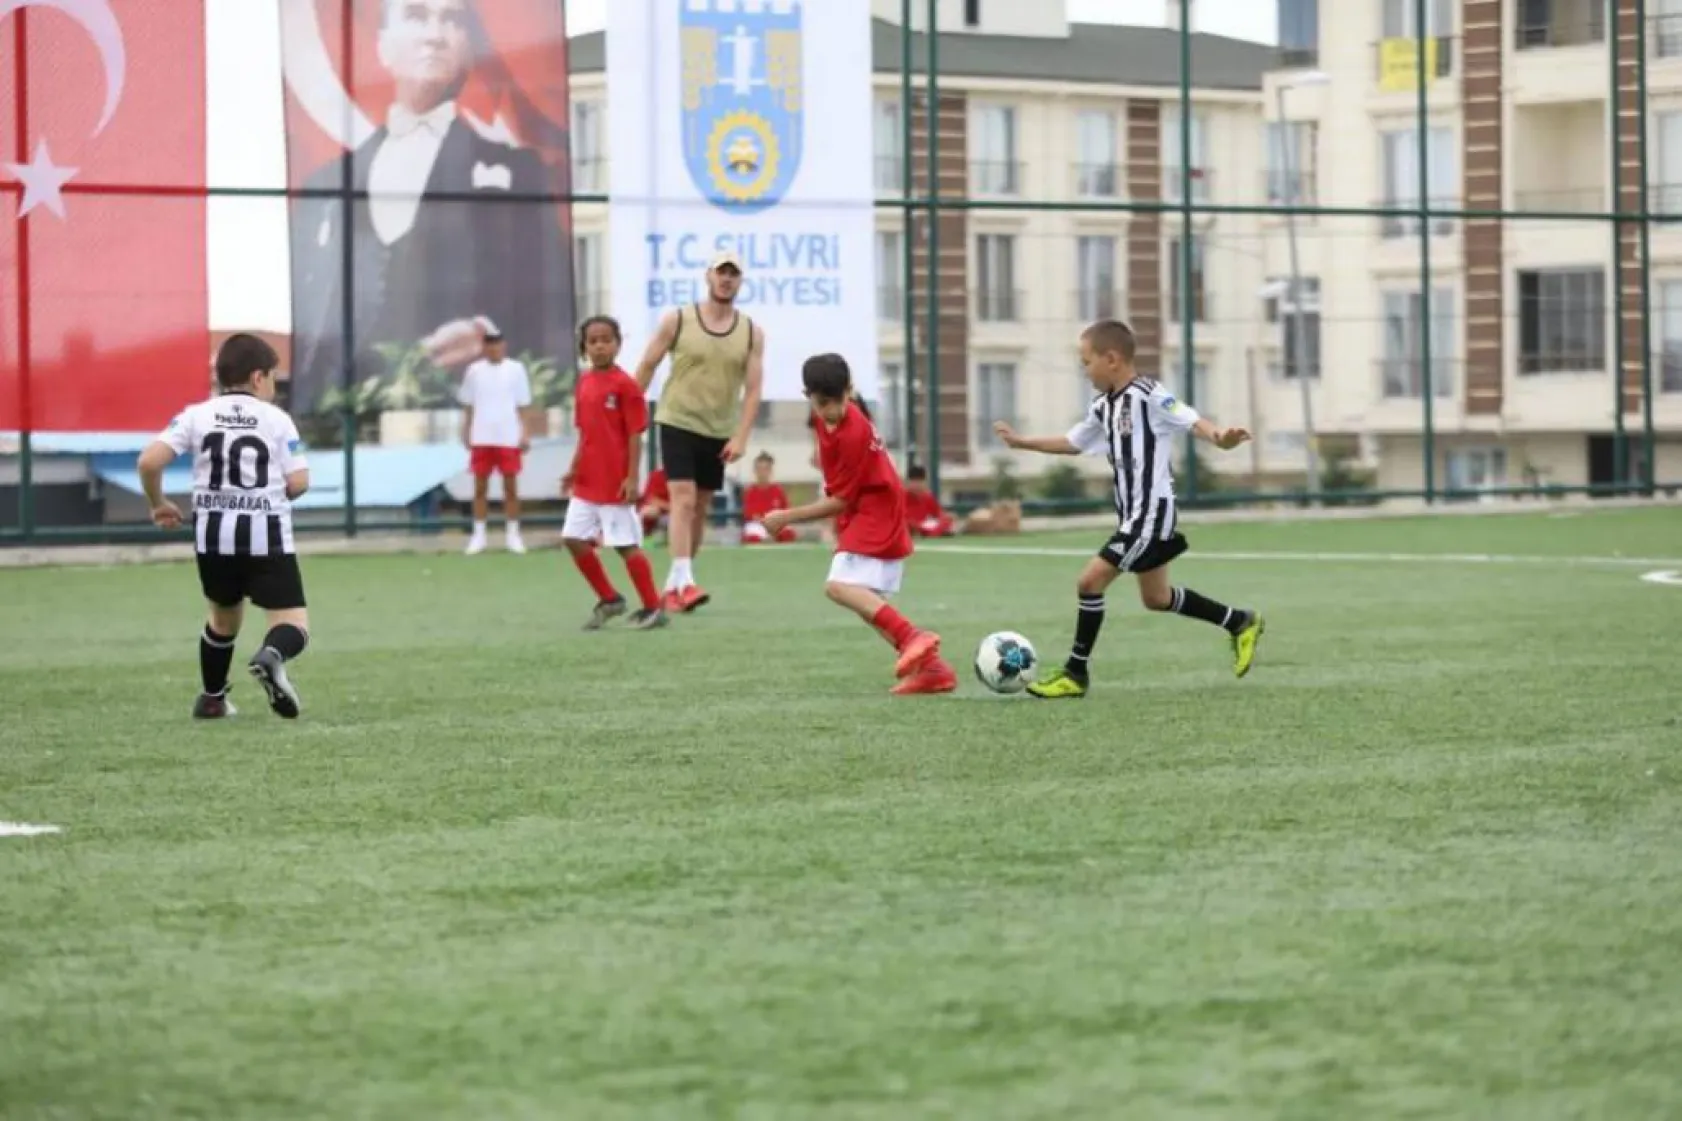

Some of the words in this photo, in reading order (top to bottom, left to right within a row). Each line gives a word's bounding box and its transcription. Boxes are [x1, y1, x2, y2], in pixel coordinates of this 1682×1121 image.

[645, 233, 706, 270] T.C.
[647, 277, 841, 308] BELDİYESİ
[201, 431, 269, 491] 10
